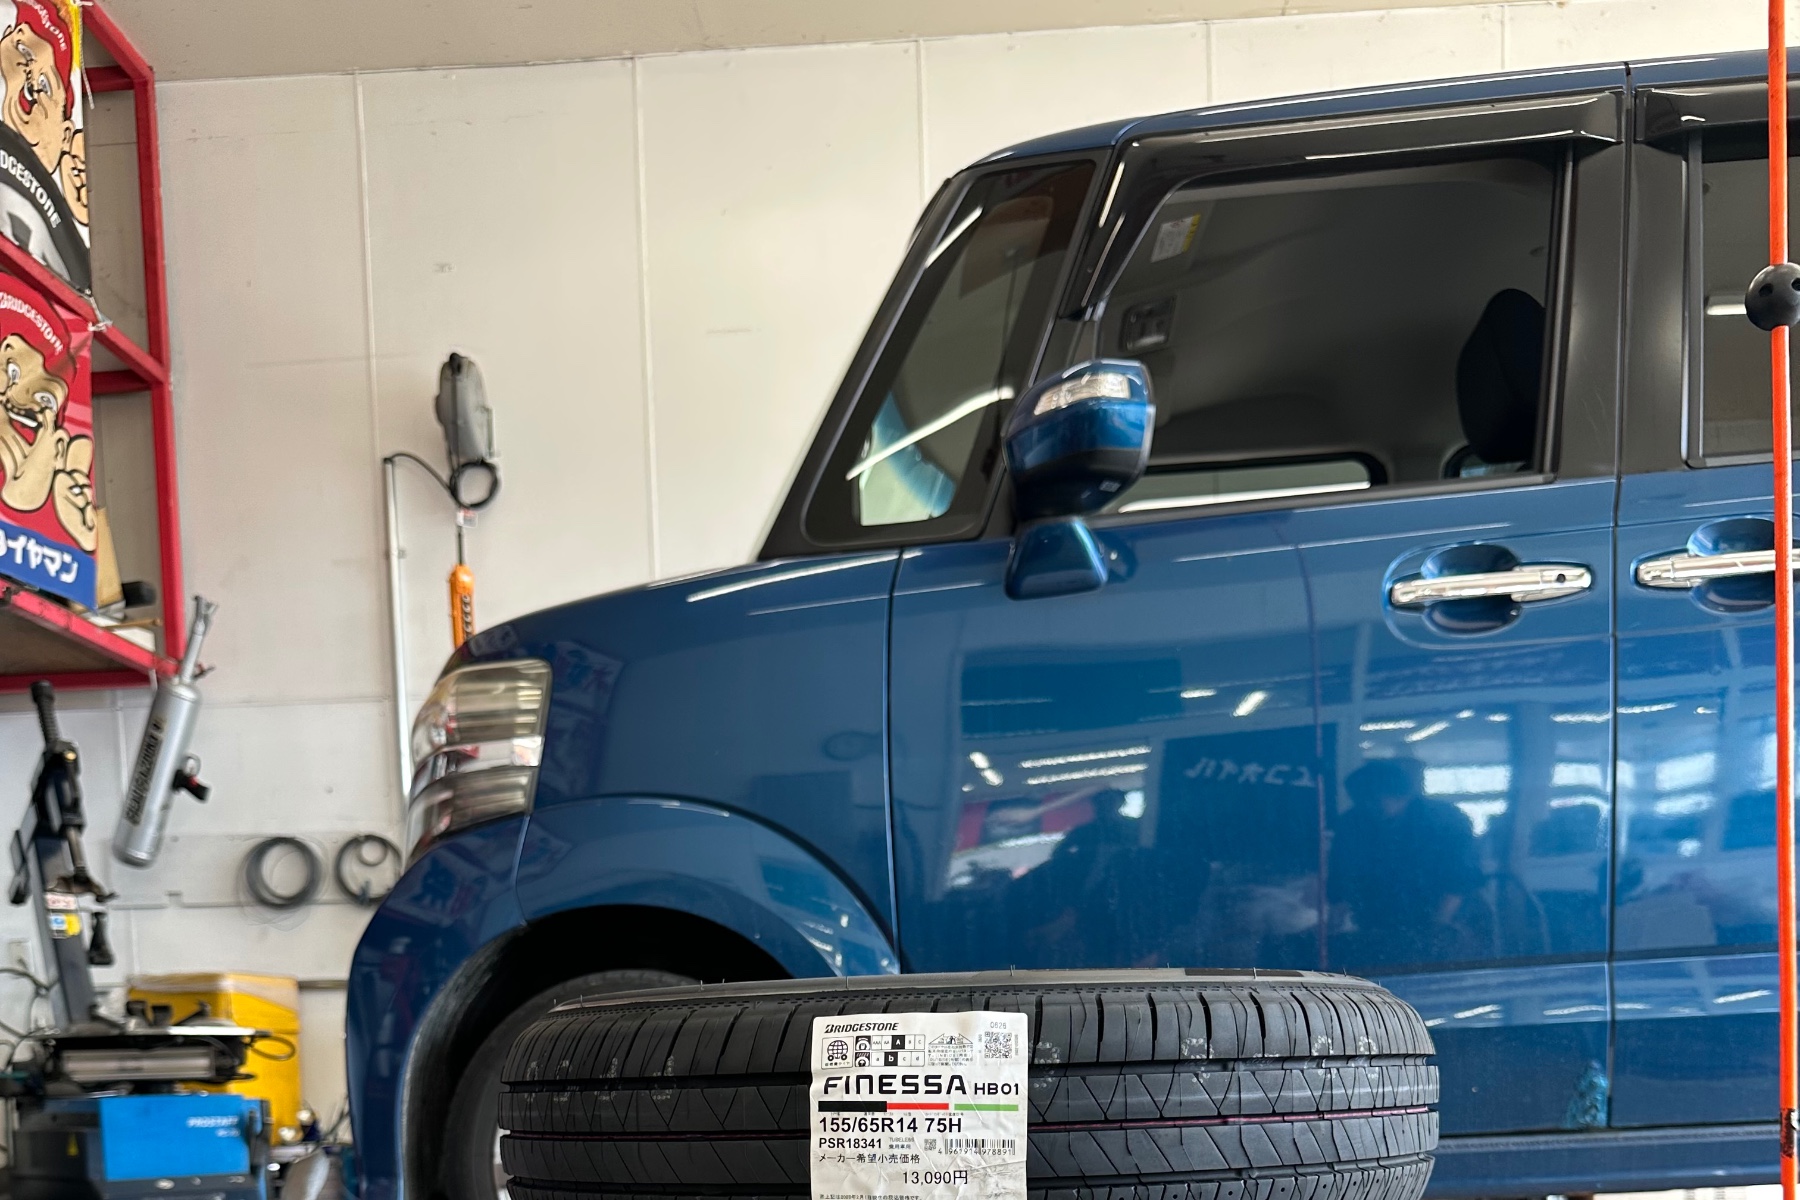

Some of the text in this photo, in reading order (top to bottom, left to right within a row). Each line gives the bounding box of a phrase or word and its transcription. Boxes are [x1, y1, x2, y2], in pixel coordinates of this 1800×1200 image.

[0, 149, 62, 229] DGESTONE
[824, 1023, 899, 1033] BRIDGESTONE
[888, 1054, 894, 1062] b
[824, 1074, 1019, 1095] FINESSA HB01
[819, 1117, 962, 1133] 155/65R14 75H
[819, 1138, 881, 1148] PSR18341
[819, 1154, 920, 1163] メーカー希望小売価格
[902, 1170, 968, 1184] 13,090円
